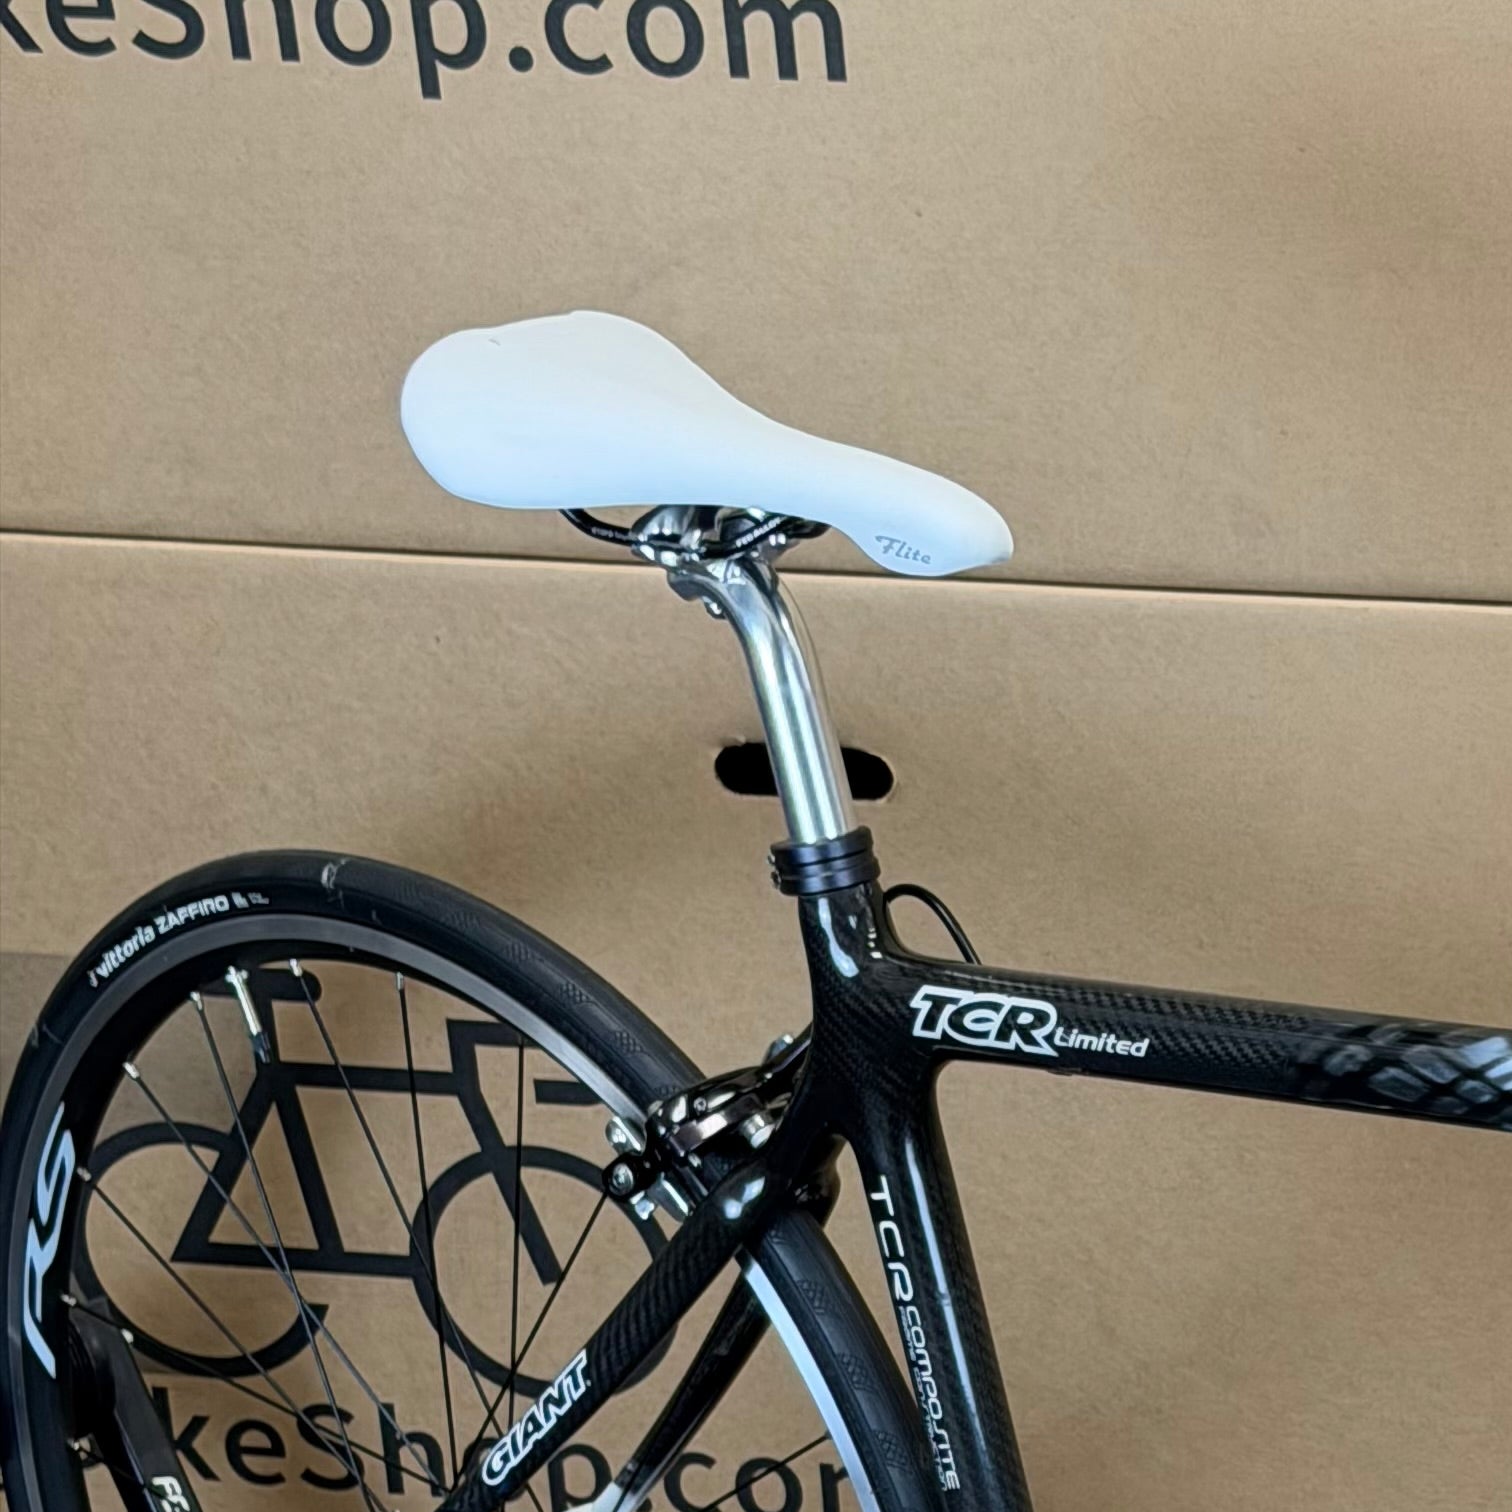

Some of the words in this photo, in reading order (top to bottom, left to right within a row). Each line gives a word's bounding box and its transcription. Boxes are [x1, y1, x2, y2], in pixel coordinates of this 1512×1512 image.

[0, 0, 848, 99] eShop.com
[875, 535, 931, 564] Flite
[96, 925, 156, 978] vittoria
[154, 894, 231, 935] ZAFFIRO
[910, 984, 1059, 1057] TCR
[1053, 1025, 1150, 1058] Limited
[870, 1174, 914, 1302] TCR
[482, 1348, 592, 1486] GIANT
